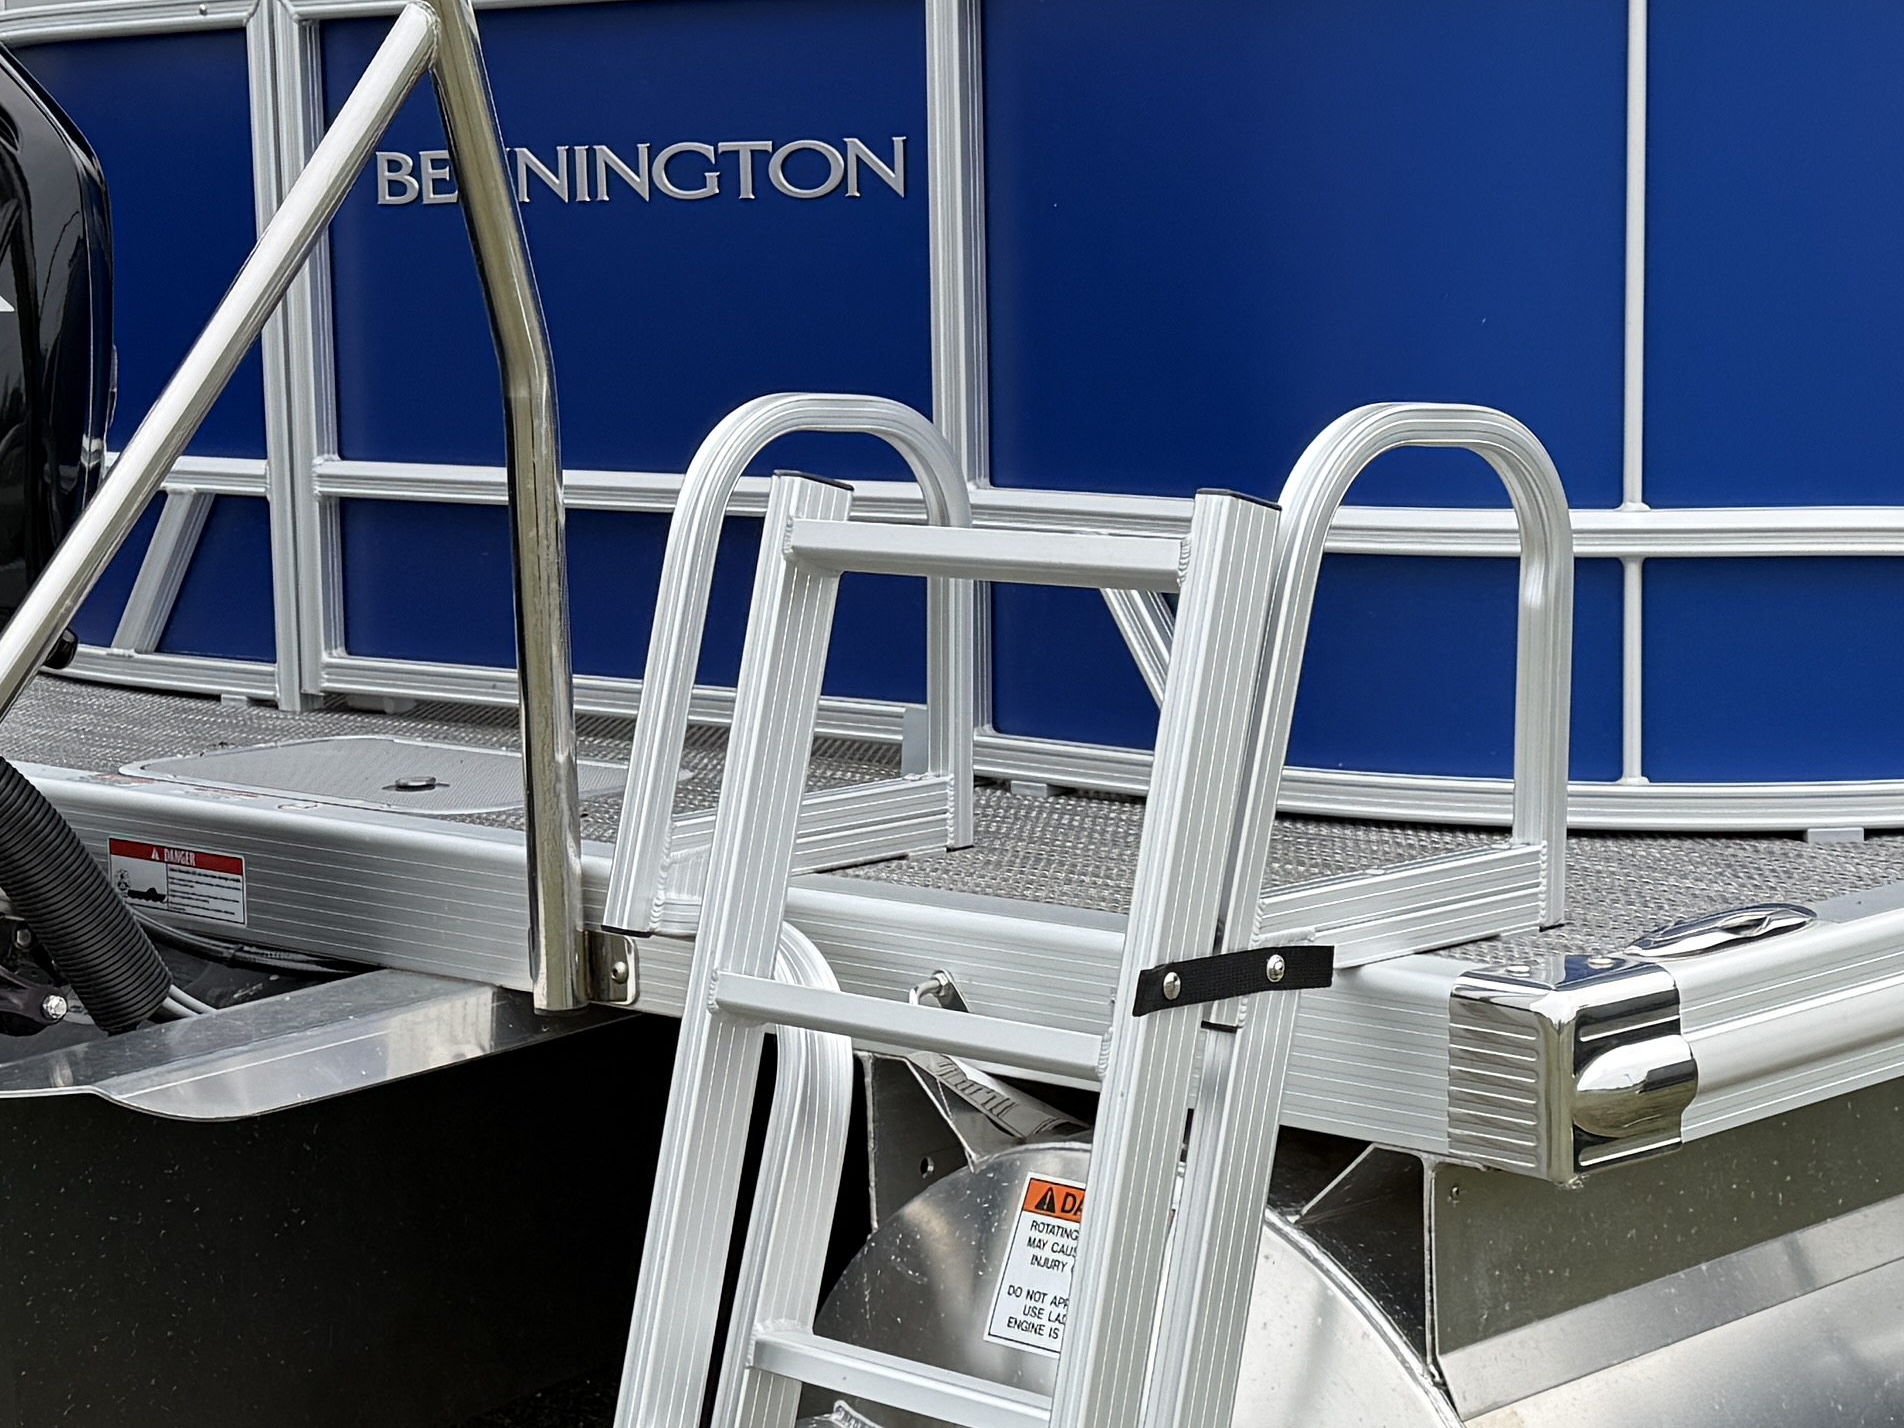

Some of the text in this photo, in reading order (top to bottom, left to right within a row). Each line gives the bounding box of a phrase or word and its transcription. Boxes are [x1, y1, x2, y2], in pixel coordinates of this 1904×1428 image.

[375, 136, 907, 205] BENINGTON
[163, 848, 196, 866] DANGER
[1030, 1219, 1080, 1241] ROTATING
[1027, 1236, 1049, 1250] MAY
[1030, 1254, 1068, 1273] INJURY
[1007, 1284, 1023, 1298] DO
[1025, 1288, 1048, 1304] NOT
[1023, 1304, 1045, 1320] USE
[1007, 1316, 1060, 1339] ENGINE IS
